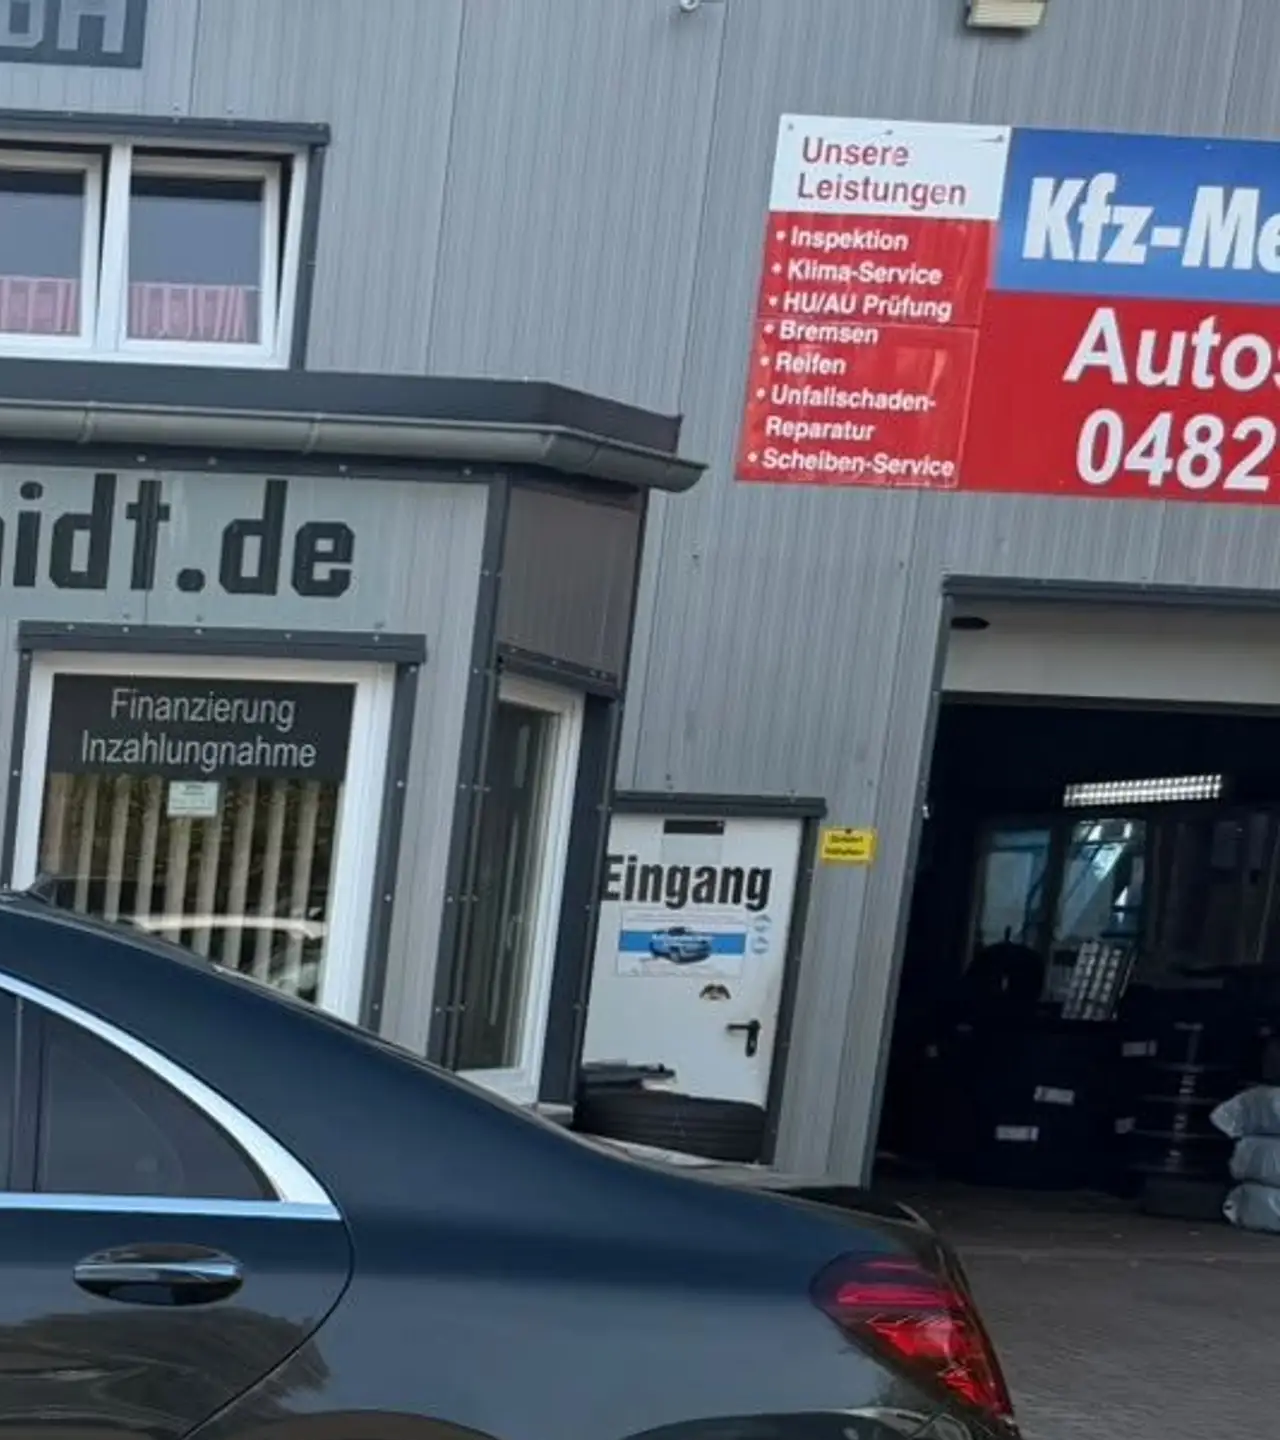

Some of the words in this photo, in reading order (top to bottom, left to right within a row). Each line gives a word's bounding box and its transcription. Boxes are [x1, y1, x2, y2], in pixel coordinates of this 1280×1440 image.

[802, 136, 909, 167] Unsere
[797, 174, 966, 211] Leistungen
[791, 226, 909, 253] Inspektion
[788, 261, 942, 286] Klima-Service
[783, 293, 854, 316] HU/AU
[862, 295, 952, 322] Prüfung
[780, 322, 879, 345] Bremsen
[775, 353, 846, 375] Reifen
[1063, 307, 1280, 392] Auto
[771, 386, 936, 412] Unfallschaden-
[765, 416, 874, 442] Reparatur
[762, 450, 954, 478] Scheiben-Service
[1076, 407, 1277, 492] 0482
[111, 688, 296, 733] Finanzierung
[82, 731, 317, 773] Inzahlungnahme
[602, 854, 773, 911] Eingang
